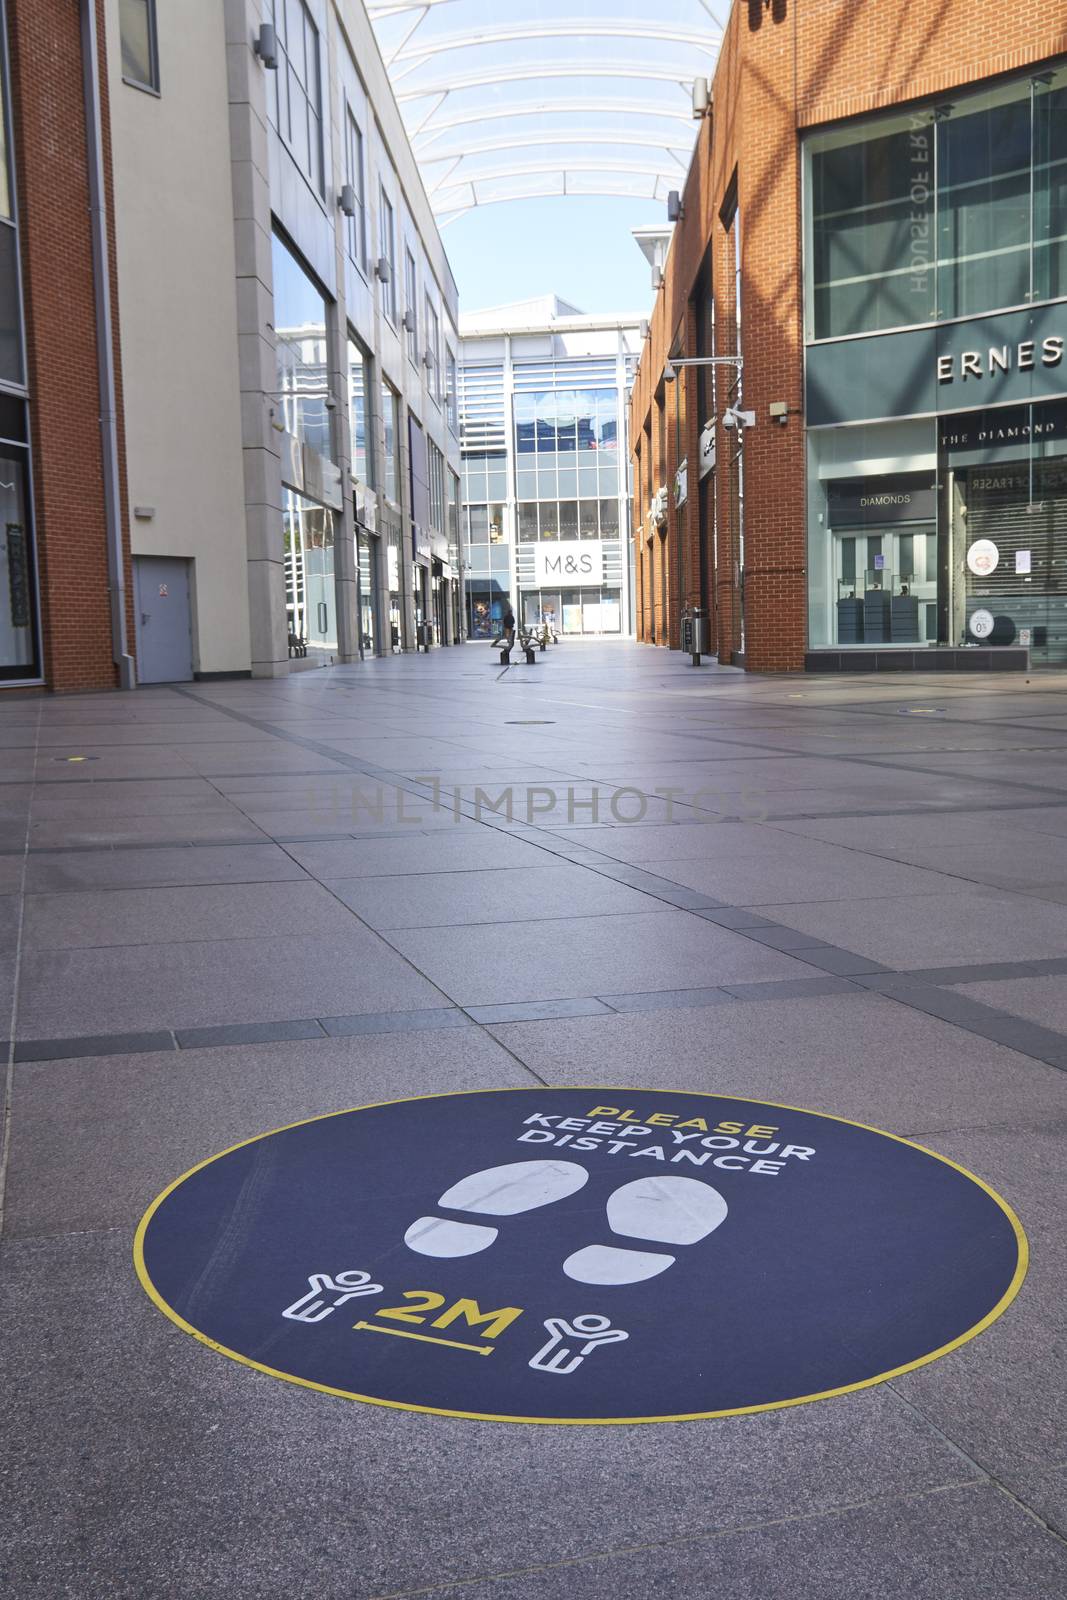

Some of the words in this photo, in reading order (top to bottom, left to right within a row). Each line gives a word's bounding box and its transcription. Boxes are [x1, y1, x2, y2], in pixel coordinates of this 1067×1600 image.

[937, 336, 1064, 380] ERNES
[941, 433, 968, 446] THE
[978, 423, 1056, 441] DIAMOND
[860, 494, 911, 507] DIAMONDS
[545, 554, 592, 575] M&S
[523, 1113, 652, 1138] KEEP
[671, 1130, 816, 1161] YOUR
[587, 1105, 779, 1139] PLEASE
[517, 1129, 787, 1176] DISTANCE
[374, 1290, 525, 1339] 2M
